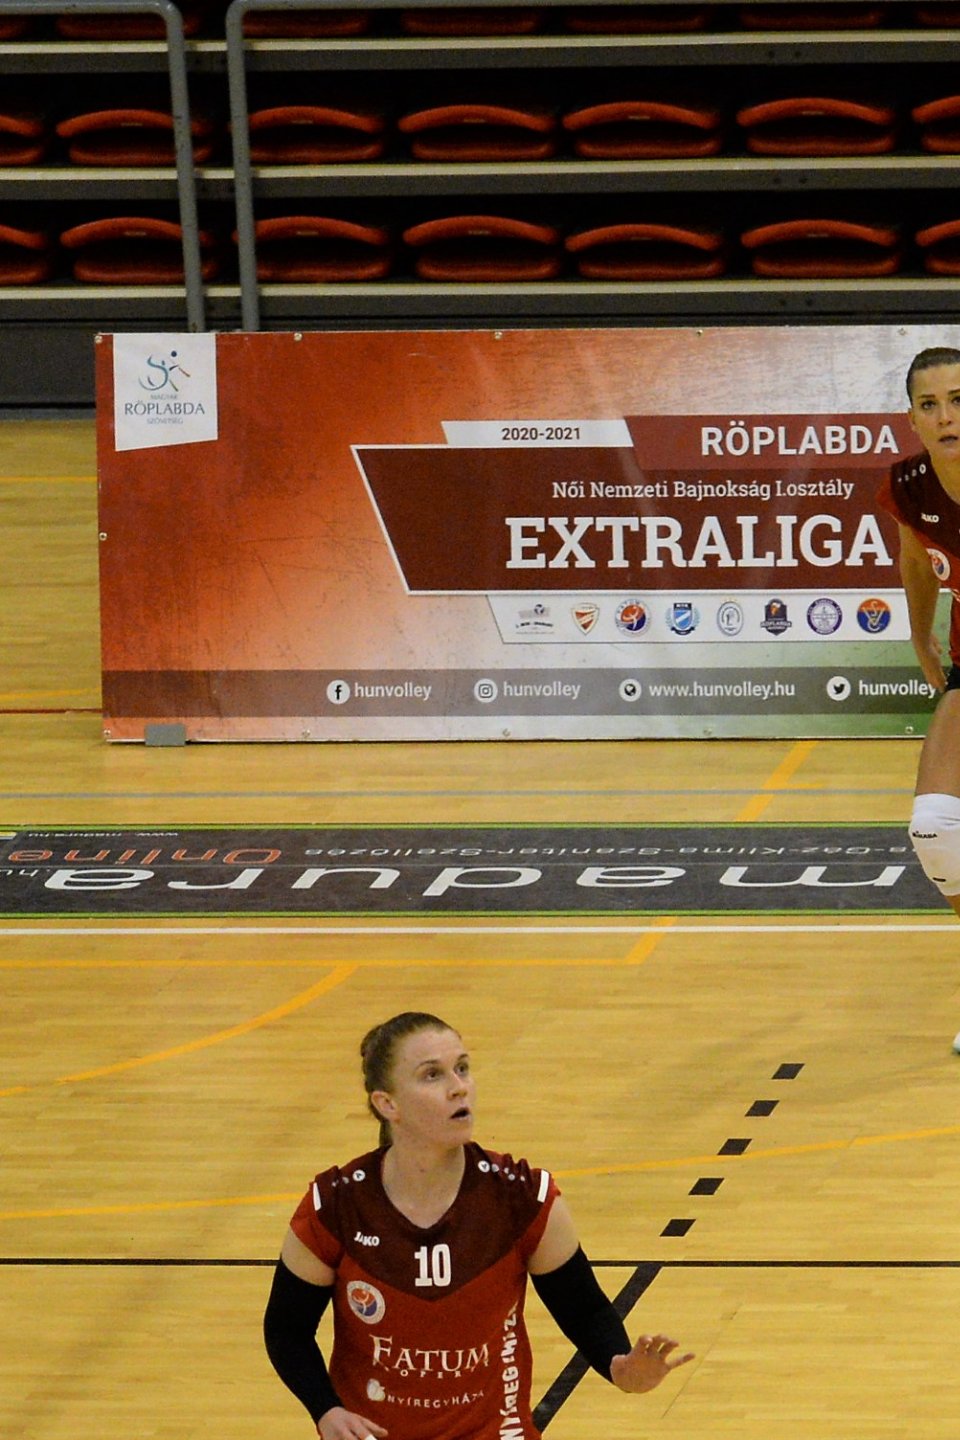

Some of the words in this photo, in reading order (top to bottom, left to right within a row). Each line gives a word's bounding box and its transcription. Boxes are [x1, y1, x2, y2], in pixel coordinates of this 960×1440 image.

[124, 400, 205, 416] RÖPLABDA
[502, 427, 581, 441] 2020-2021
[701, 420, 899, 456] RÖPLABDA
[551, 481, 585, 499] Női
[590, 480, 669, 498] Nemzeti
[673, 479, 771, 501] Bajnokság
[505, 513, 894, 569] EXTRALIGA
[354, 682, 432, 700] hunvolley
[503, 682, 581, 699] hunvolley
[649, 681, 795, 700] www.hunvolley.hu
[858, 680, 937, 699] hunvolley
[354, 1231, 380, 1247] JAKO
[414, 1243, 451, 1287] 10
